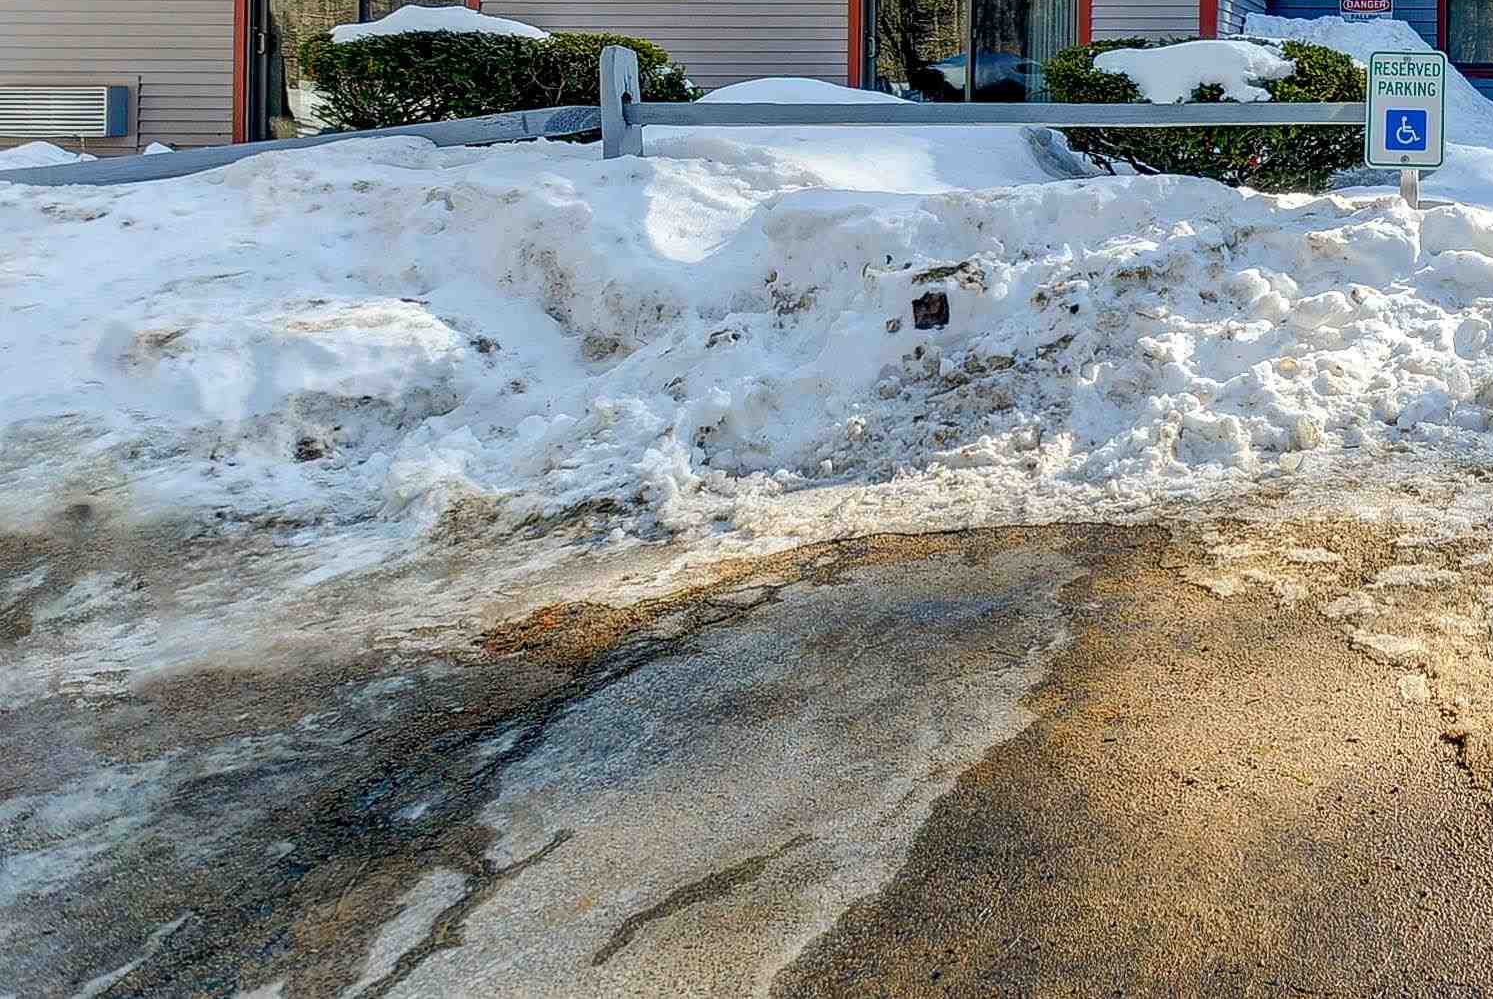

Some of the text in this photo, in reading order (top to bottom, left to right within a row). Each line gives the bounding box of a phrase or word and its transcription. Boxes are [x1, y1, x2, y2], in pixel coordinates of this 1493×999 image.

[1346, 0, 1386, 9] DANGER
[1374, 62, 1440, 76] RESERVED
[1378, 82, 1436, 96] PARKING
